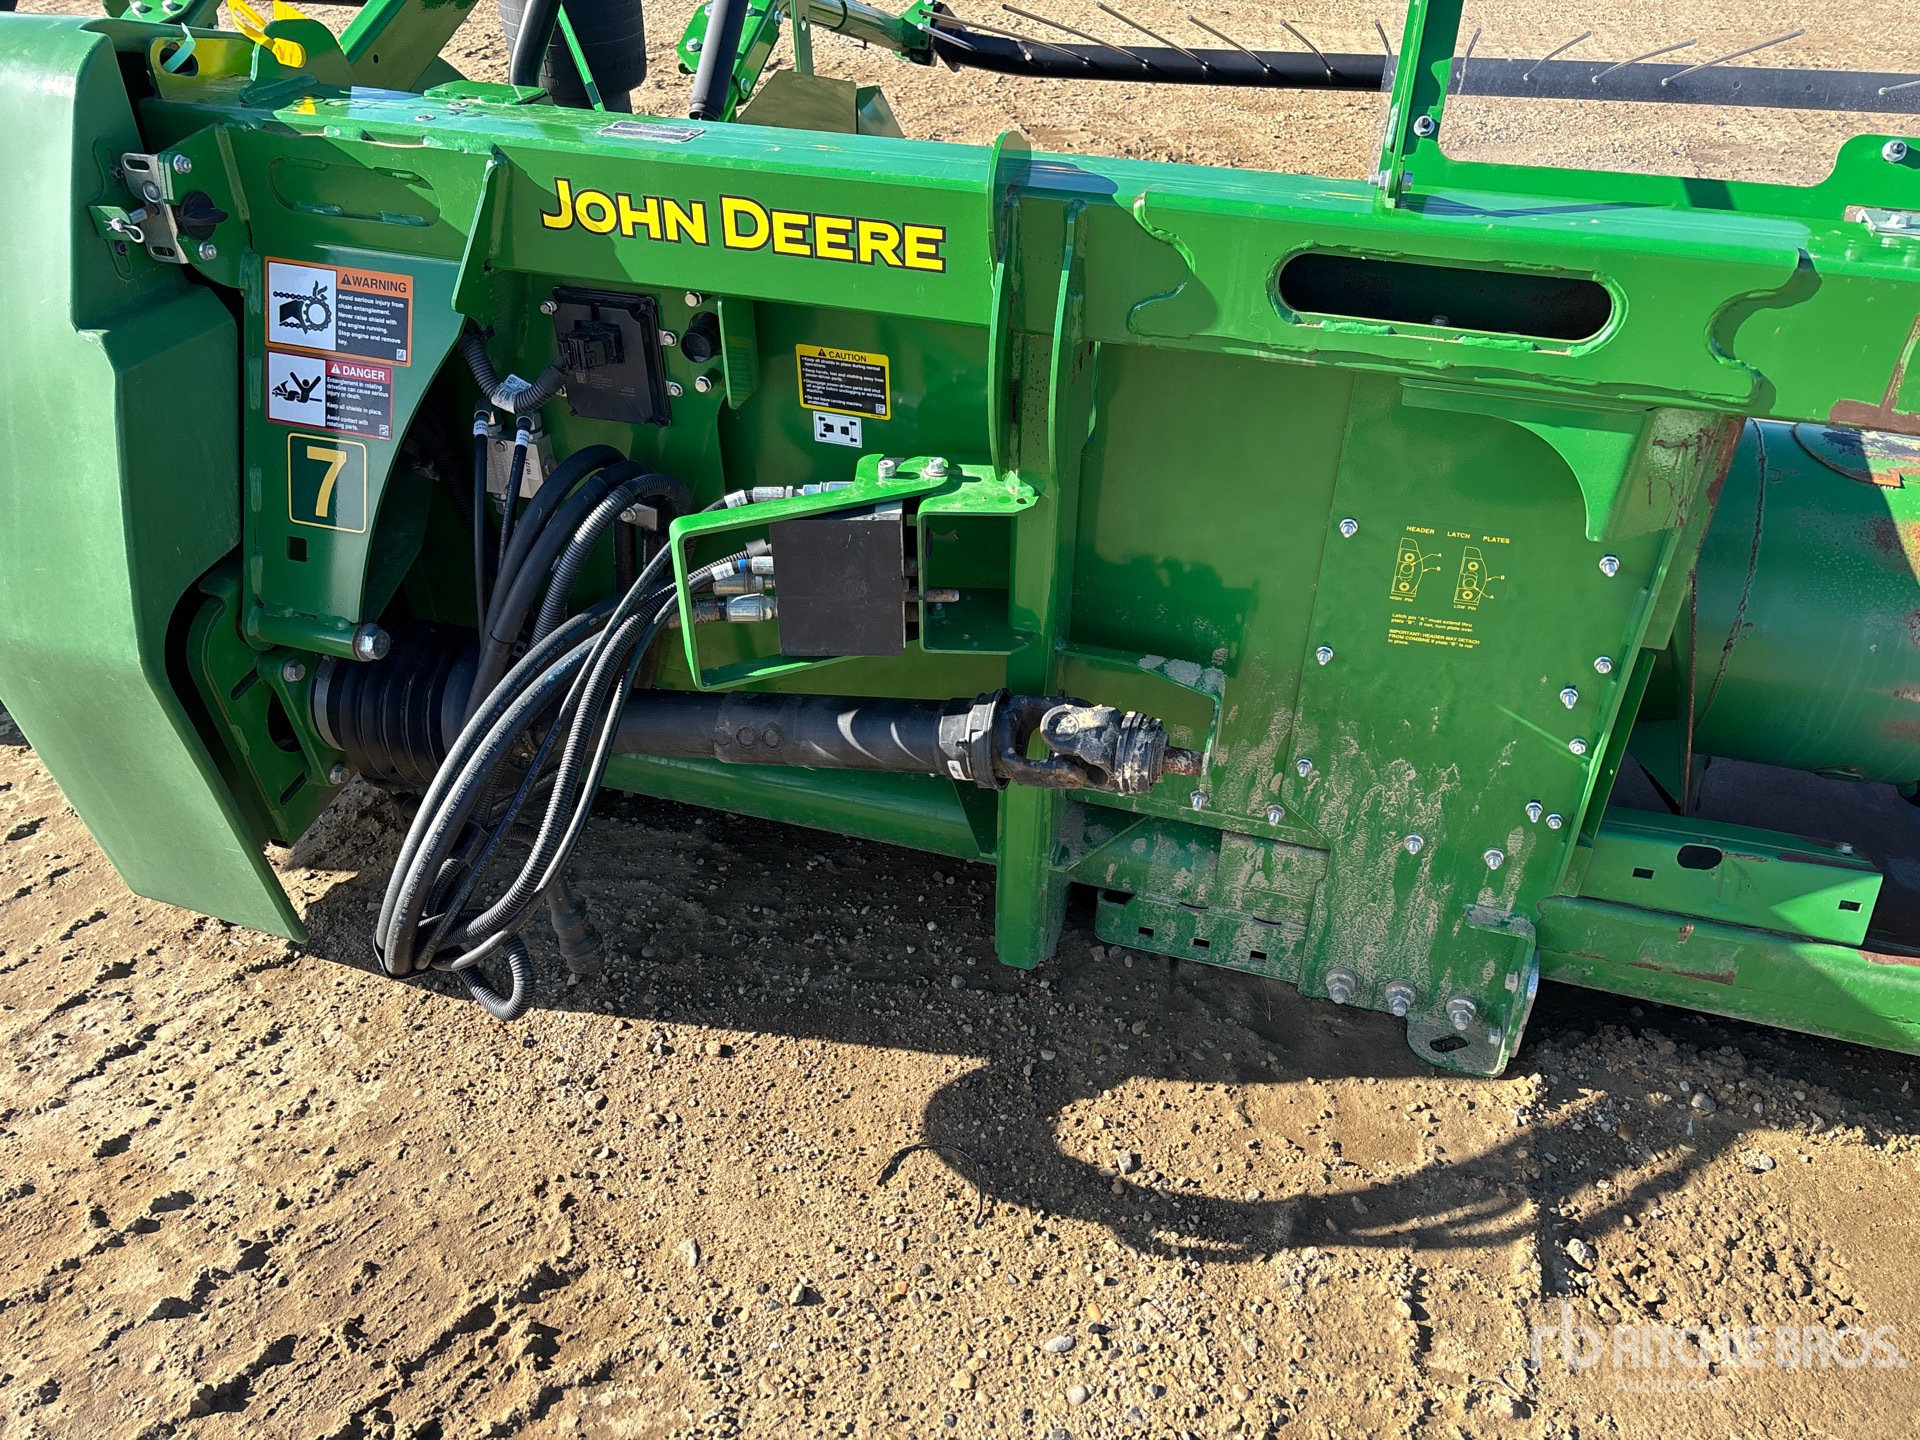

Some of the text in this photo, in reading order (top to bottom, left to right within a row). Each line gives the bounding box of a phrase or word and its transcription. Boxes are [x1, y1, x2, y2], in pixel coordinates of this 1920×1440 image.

[539, 177, 947, 274] JOHN DEERE
[352, 276, 407, 293] WARNING
[354, 296, 374, 304] serious
[375, 299, 390, 307] injury
[353, 306, 391, 315] entanglement.
[366, 324, 388, 334] running.
[829, 351, 867, 362] CAUTION
[343, 366, 385, 380] DANGER
[327, 377, 358, 386] Entanglement
[365, 383, 383, 391] rotating
[346, 404, 362, 412] shields
[306, 446, 347, 518] 7
[1406, 525, 1510, 544] HEADER LATCH PLATES
